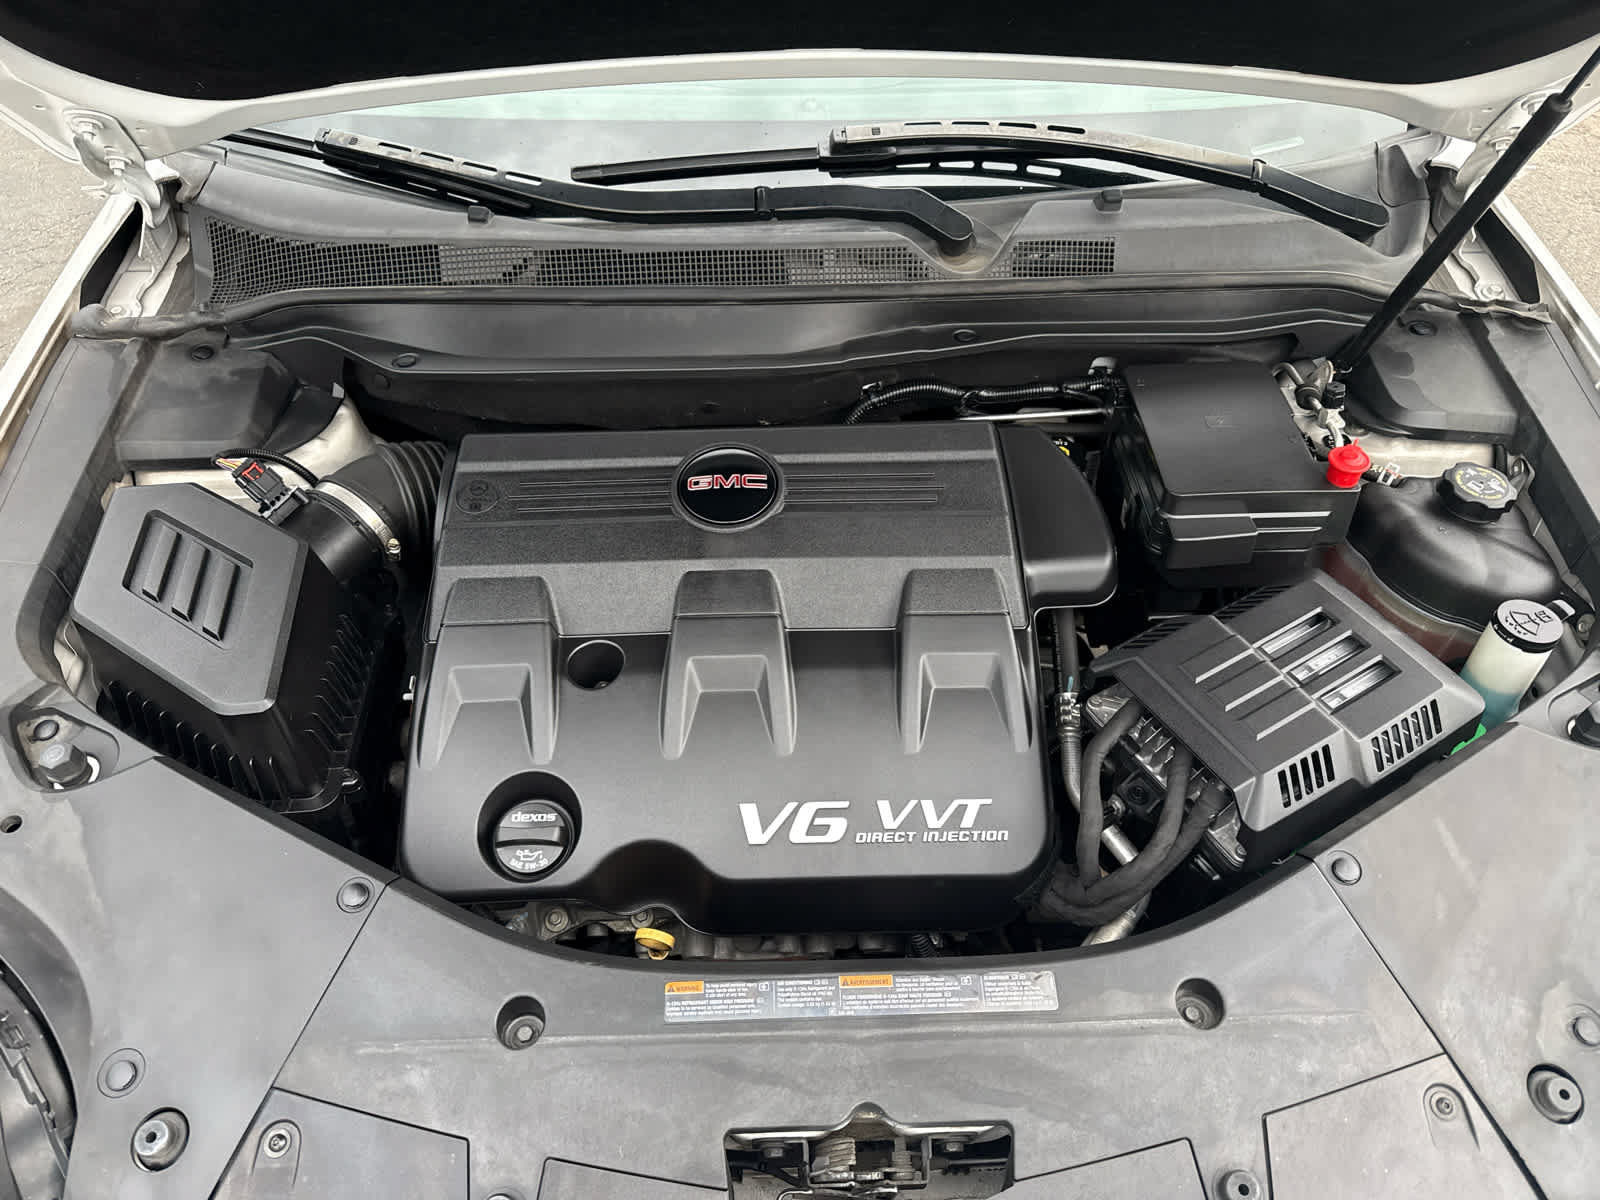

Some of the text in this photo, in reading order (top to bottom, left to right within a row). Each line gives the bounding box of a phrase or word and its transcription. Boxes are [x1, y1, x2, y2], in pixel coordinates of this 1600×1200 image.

[687, 473, 768, 491] GMC
[511, 811, 558, 823] dexos
[739, 798, 993, 845] V6 VVT
[855, 829, 1010, 844] DIRECT INJECTION
